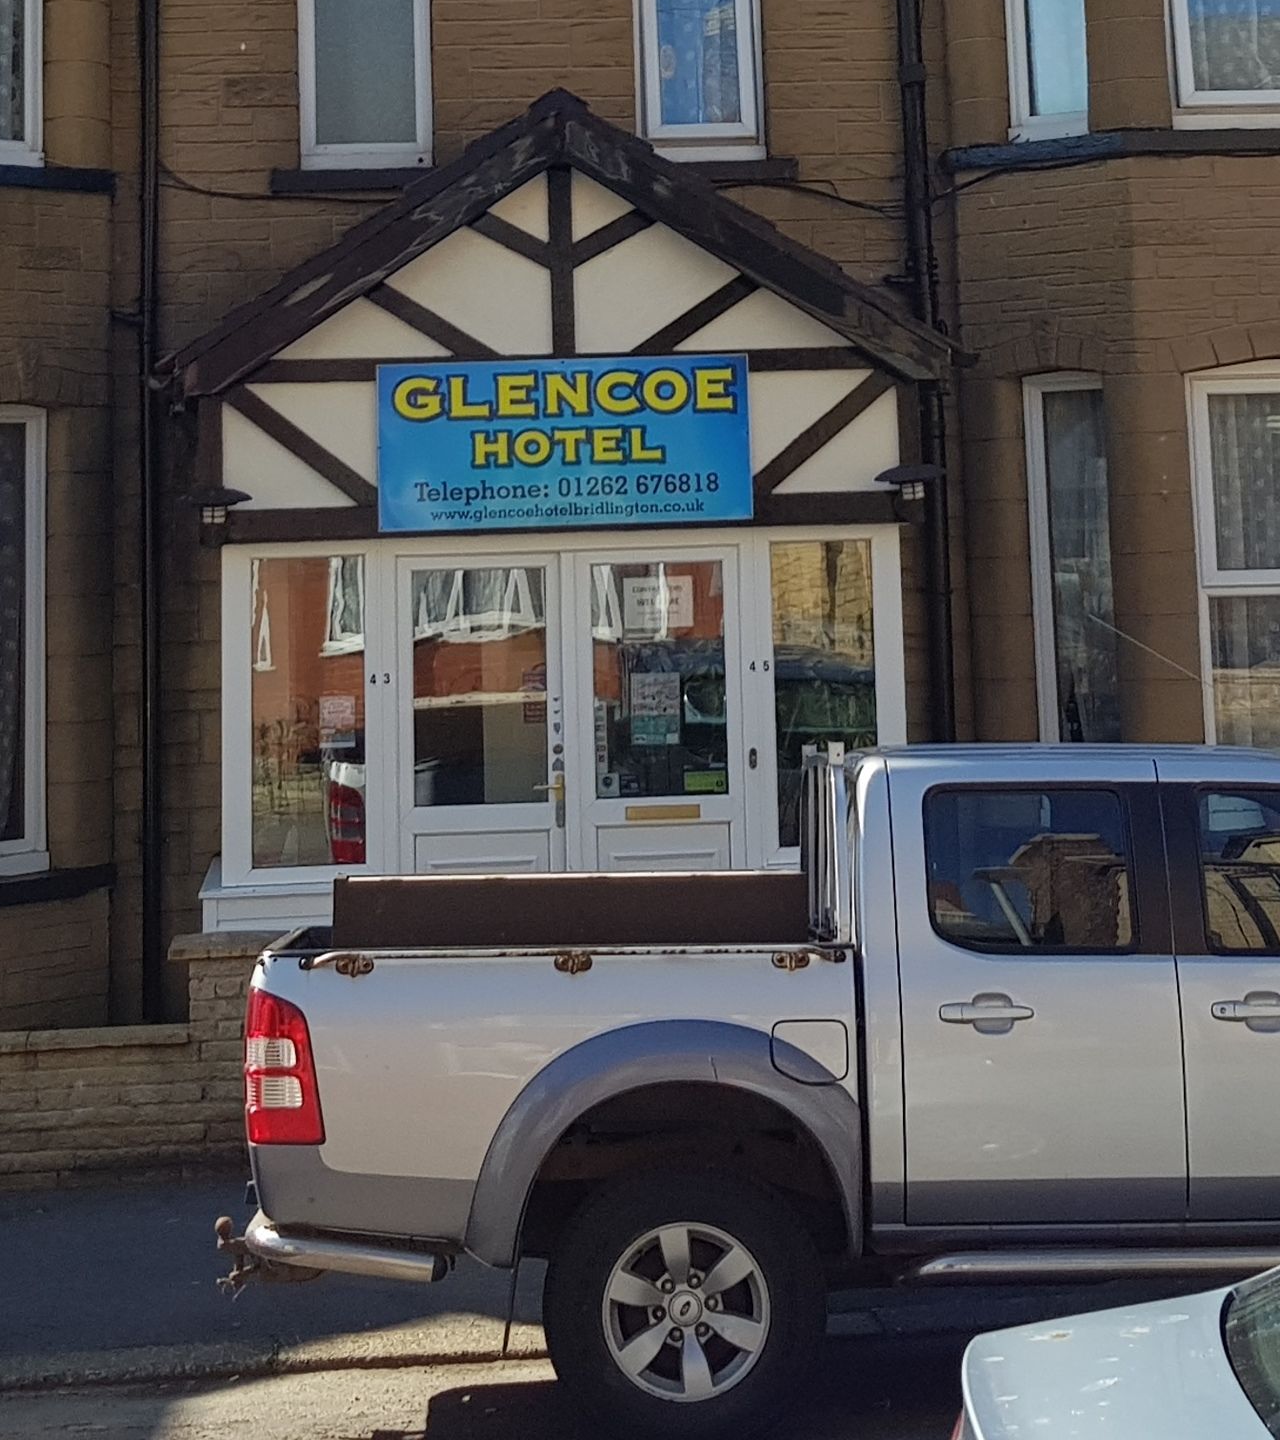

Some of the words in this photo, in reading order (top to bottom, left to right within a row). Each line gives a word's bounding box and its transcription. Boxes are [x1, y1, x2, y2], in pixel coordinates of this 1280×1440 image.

[393, 366, 736, 421] GLENCOE
[471, 424, 666, 469] HOTEL
[414, 480, 549, 506] Telephone:
[558, 475, 628, 497] 01262
[636, 472, 719, 495] 676818
[430, 499, 704, 522] www.glencoehotelbridlington.co.uk
